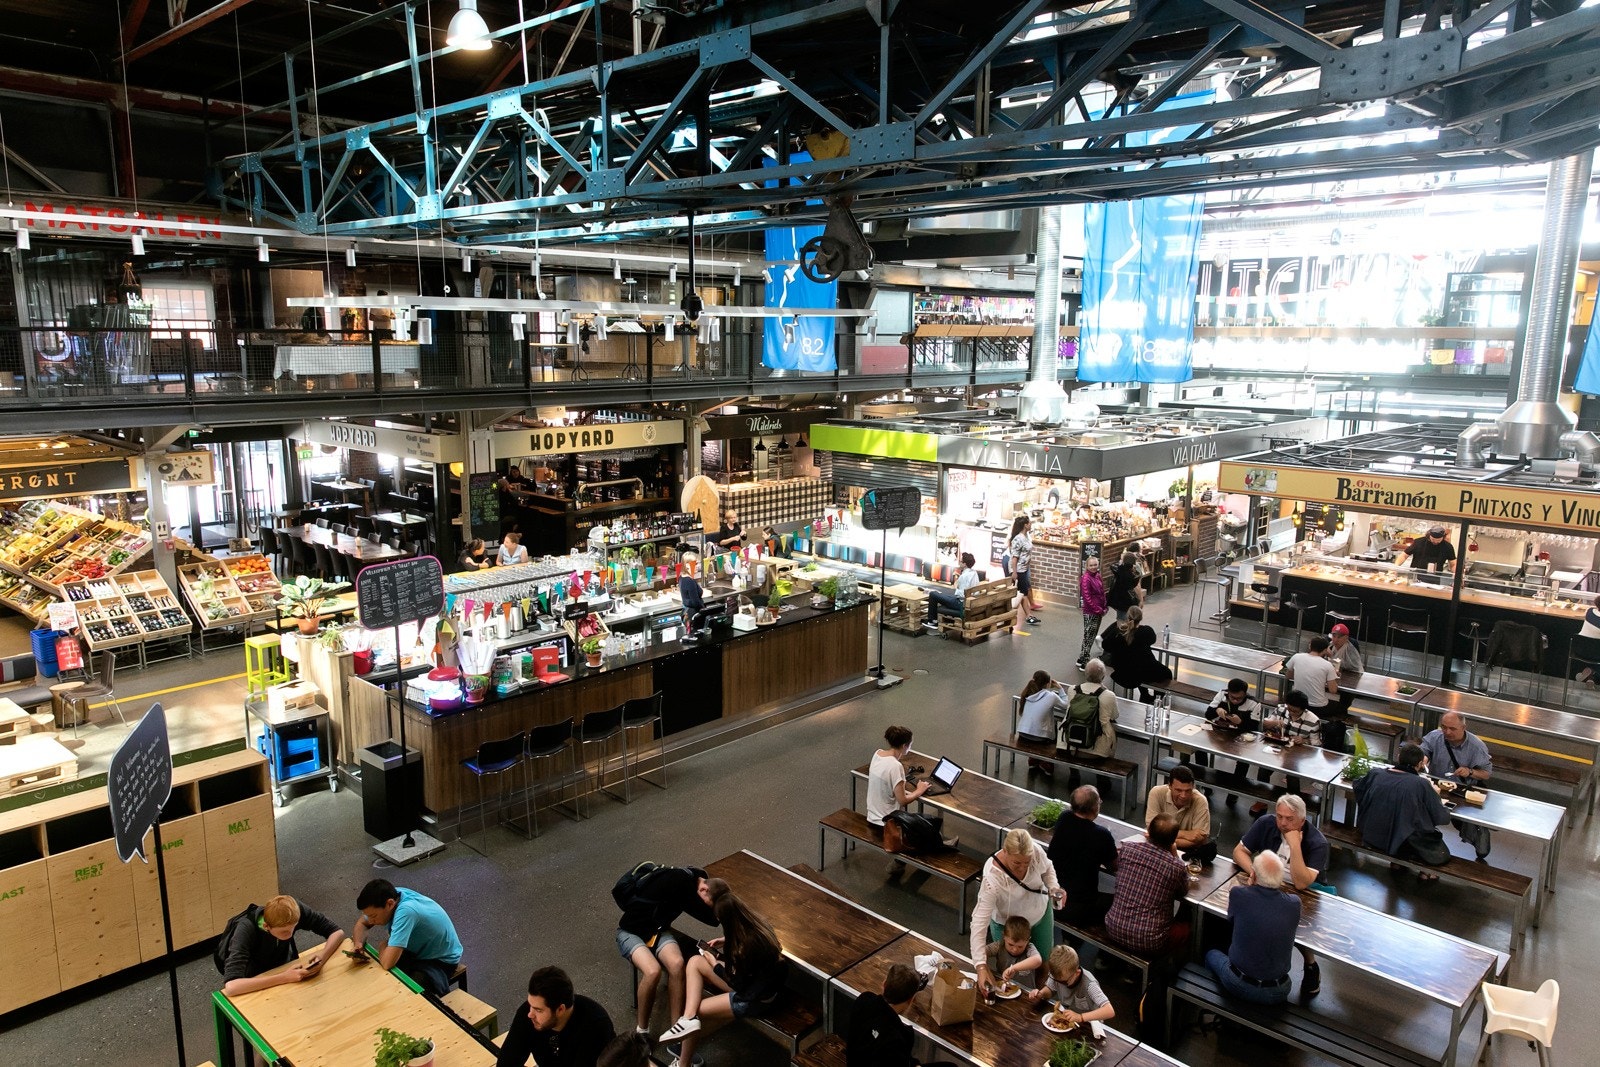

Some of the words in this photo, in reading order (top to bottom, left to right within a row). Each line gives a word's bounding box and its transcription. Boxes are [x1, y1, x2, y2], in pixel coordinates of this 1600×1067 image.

[24, 201, 223, 239] MATSALEN
[330, 424, 377, 448] HOPYARD
[530, 429, 614, 451] HOPYARD
[970, 447, 1002, 466] VIA
[1005, 450, 1063, 474] ITALIA
[1172, 445, 1189, 465] VIA
[1190, 441, 1218, 462] ITALIA
[1335, 477, 1437, 510] Barramón
[1459, 490, 1532, 519] PINTXOS
[74, 862, 104, 877] REST
[0, 886, 25, 901] AST
